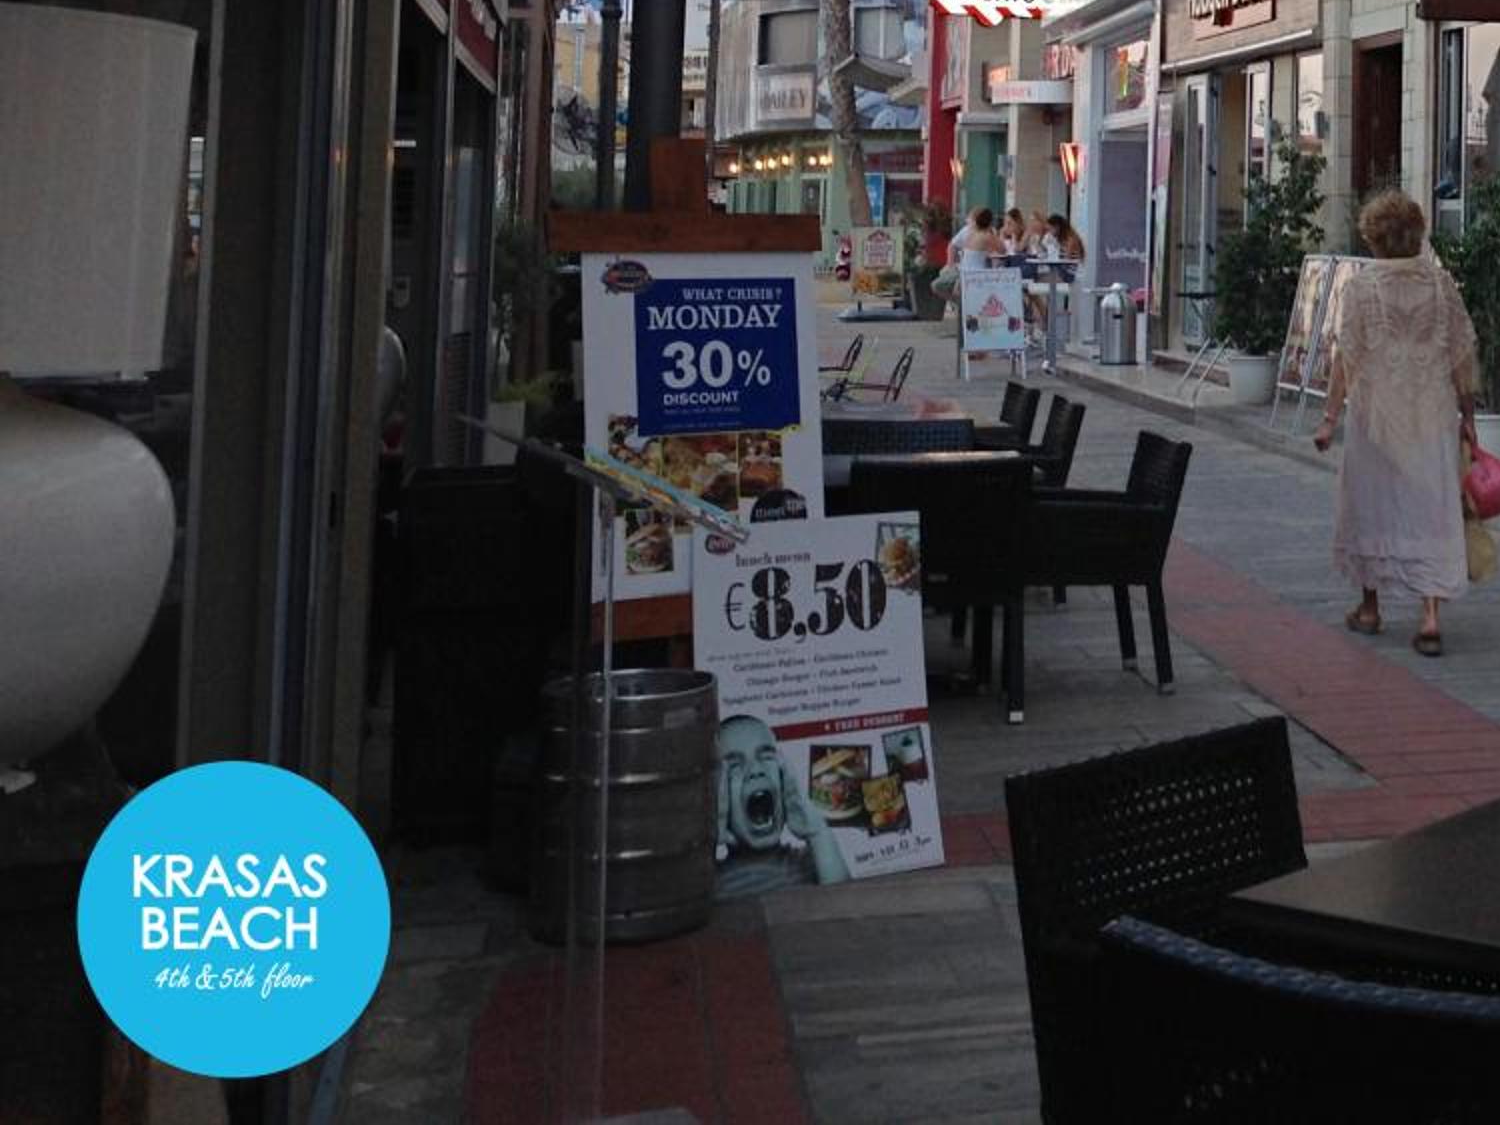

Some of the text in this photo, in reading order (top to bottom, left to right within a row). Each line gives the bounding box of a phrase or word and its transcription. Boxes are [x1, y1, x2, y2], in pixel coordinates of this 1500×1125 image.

[682, 287, 724, 300] WHAT
[647, 305, 782, 331] MONDAY
[662, 339, 772, 390] 30%
[663, 390, 739, 406] DISCOUNT
[723, 558, 888, 644] €8,50
